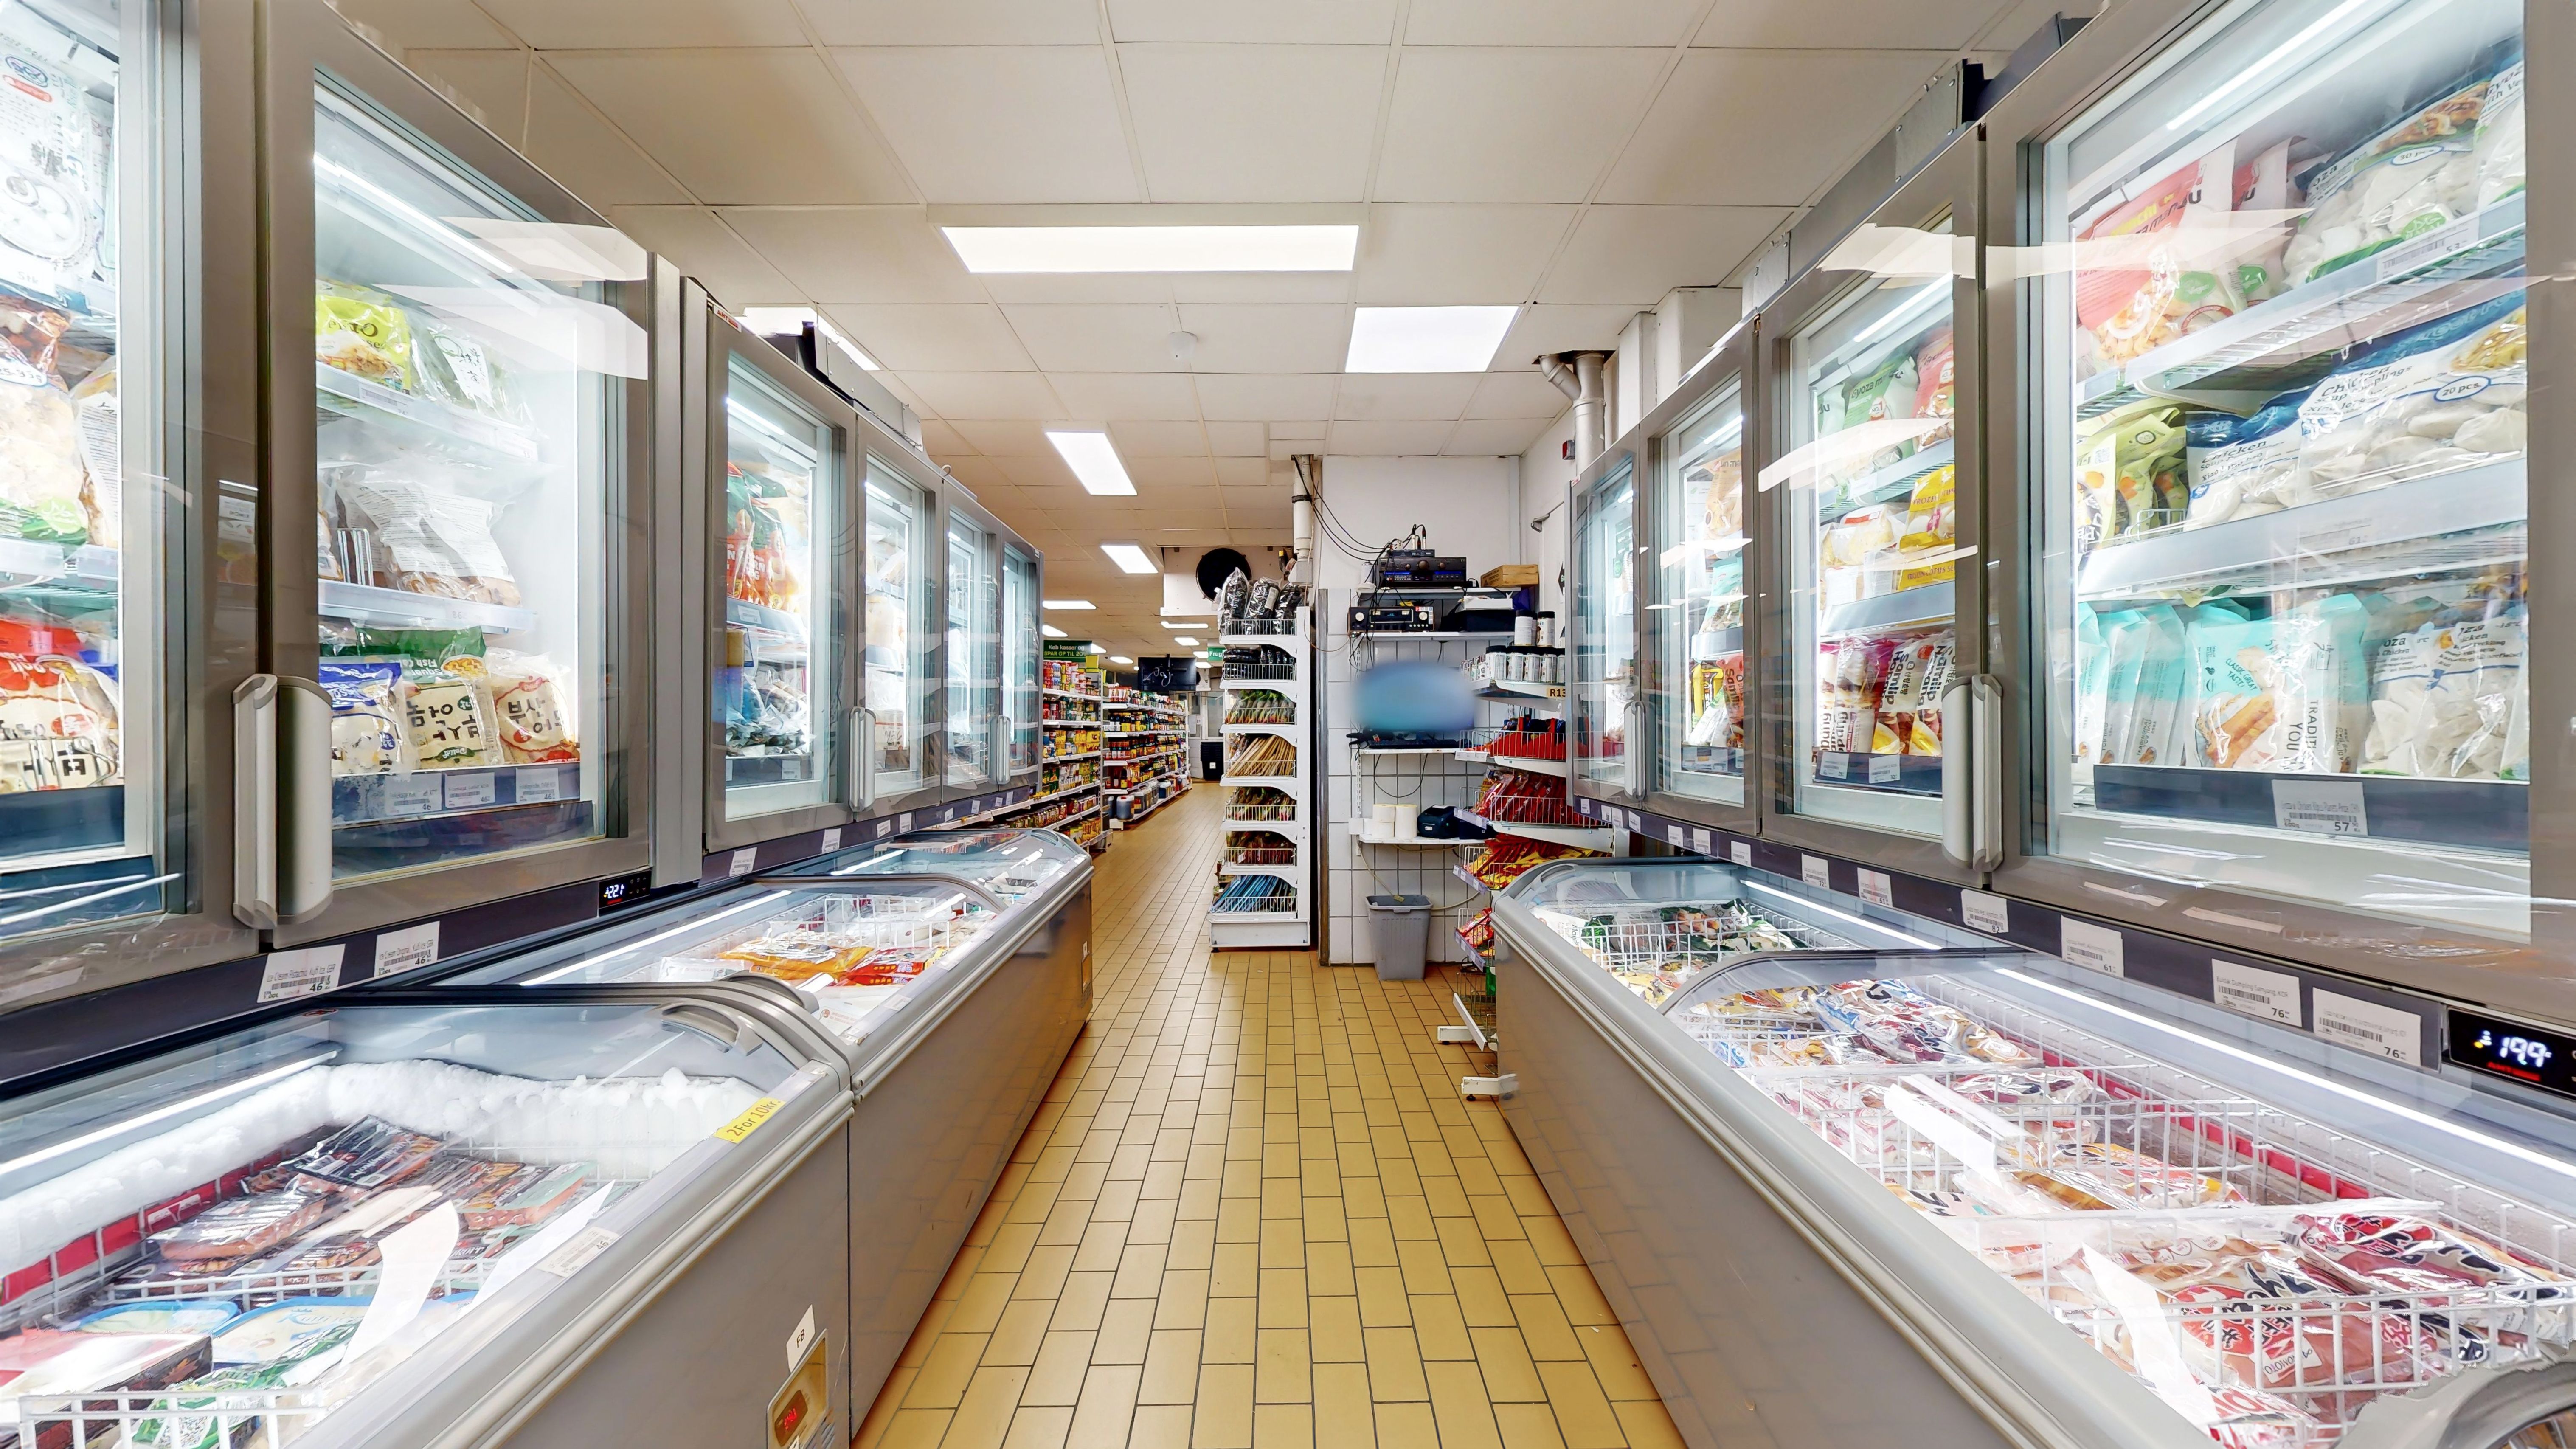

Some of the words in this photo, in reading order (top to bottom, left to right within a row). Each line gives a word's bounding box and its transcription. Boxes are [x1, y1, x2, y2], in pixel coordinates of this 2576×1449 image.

[1851, 381, 1874, 399] Gyoza
[2382, 638, 2406, 647] oza
[417, 659, 438, 667] Fish
[411, 669, 443, 677] Squar
[1926, 646, 1954, 701] Samlip
[1884, 653, 1910, 705] Samlip
[2287, 723, 2303, 751] YOU
[2335, 822, 2349, 832] 57
[415, 957, 426, 965] 46
[2104, 964, 2112, 972] 61
[309, 982, 323, 991] 46
[2271, 1007, 2284, 1018] 76
[2383, 1046, 2400, 1058] 76
[797, 1329, 805, 1348] F8
[2264, 1349, 2312, 1374] AOMOTO
